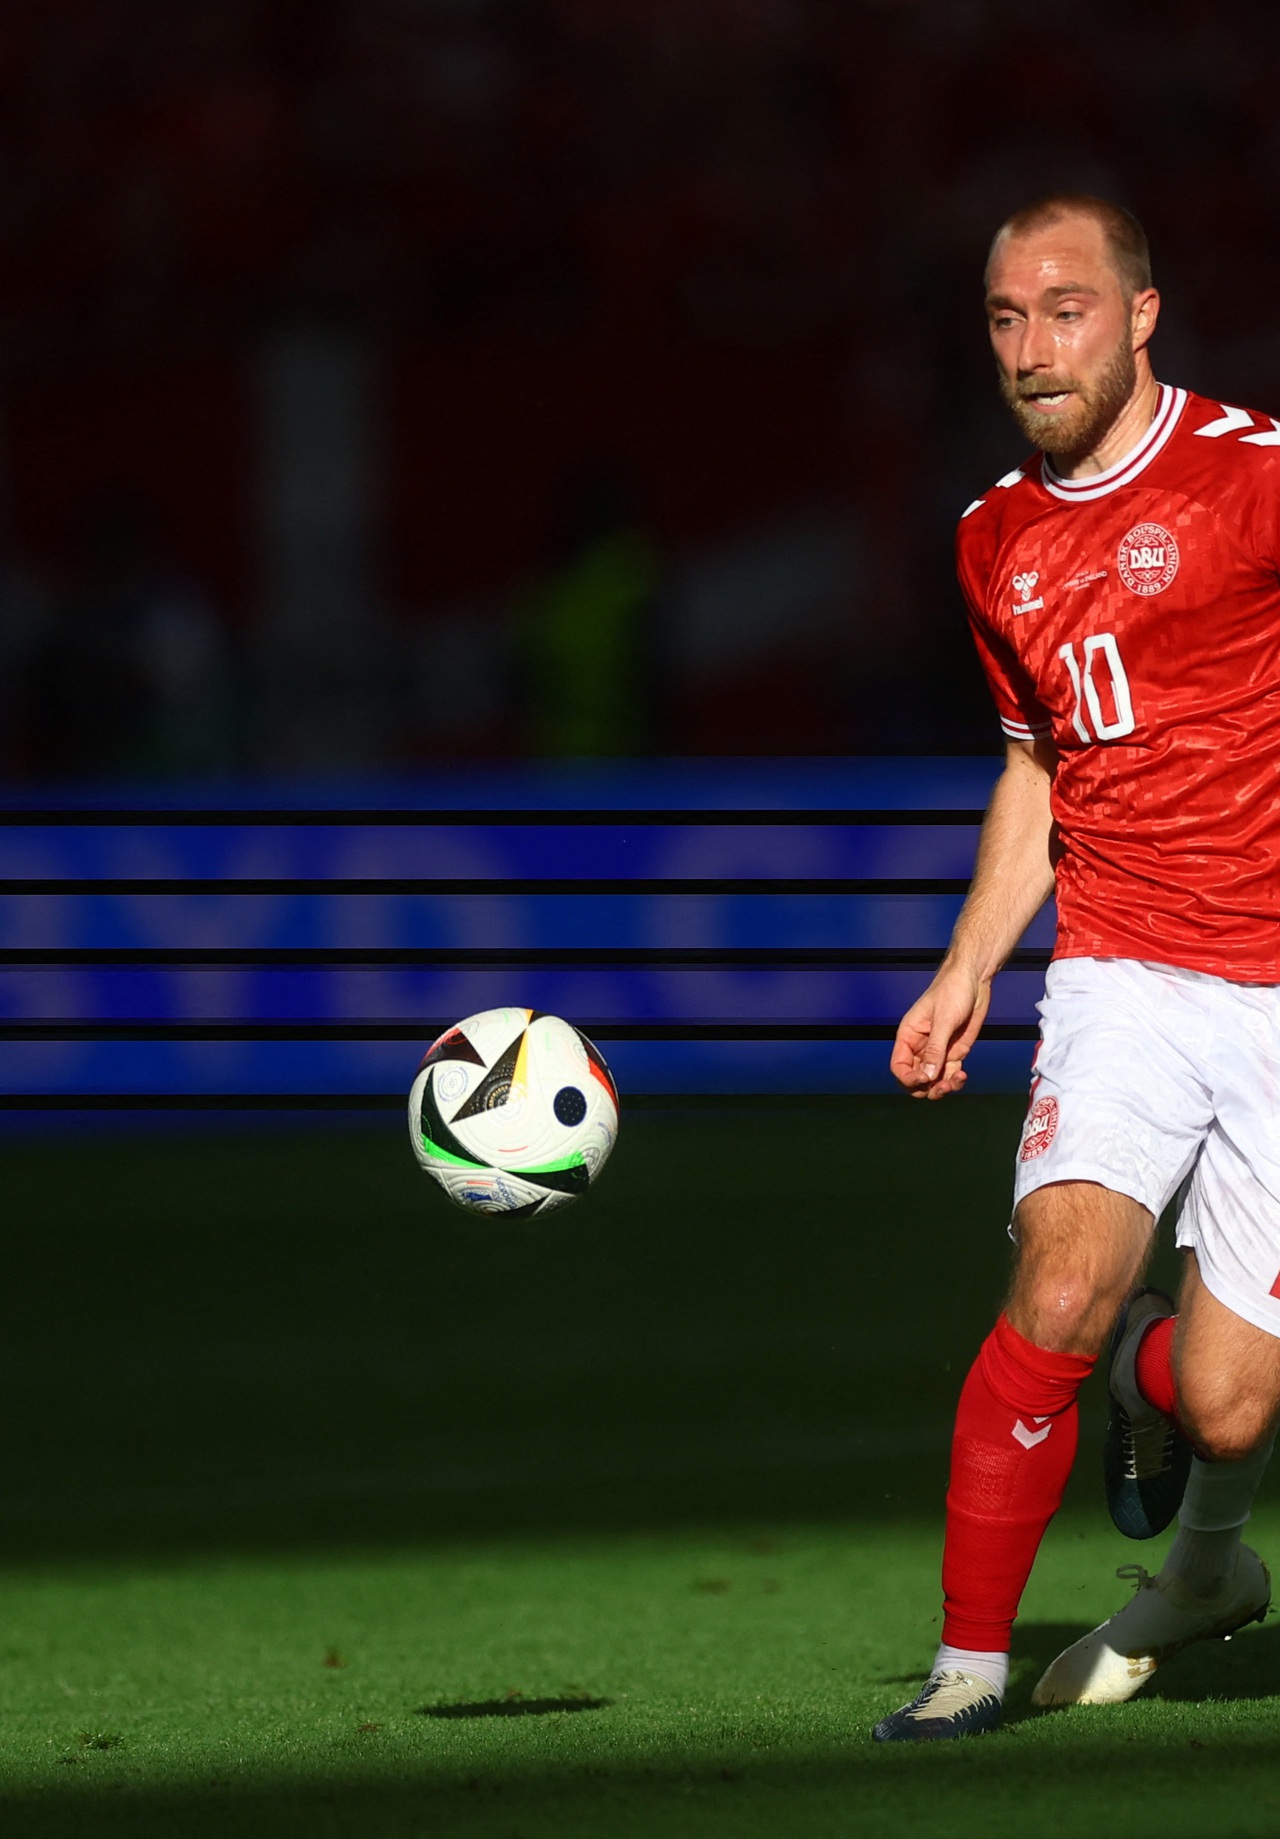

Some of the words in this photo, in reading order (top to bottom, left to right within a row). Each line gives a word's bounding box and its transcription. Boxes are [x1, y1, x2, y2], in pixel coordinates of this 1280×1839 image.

[1120, 546, 1136, 587] DANSK
[1162, 544, 1177, 583] UNION
[1130, 547, 1165, 569] DBU
[1137, 583, 1161, 593] 1889
[1012, 596, 1044, 616] hummel
[1058, 633, 1135, 743] 10
